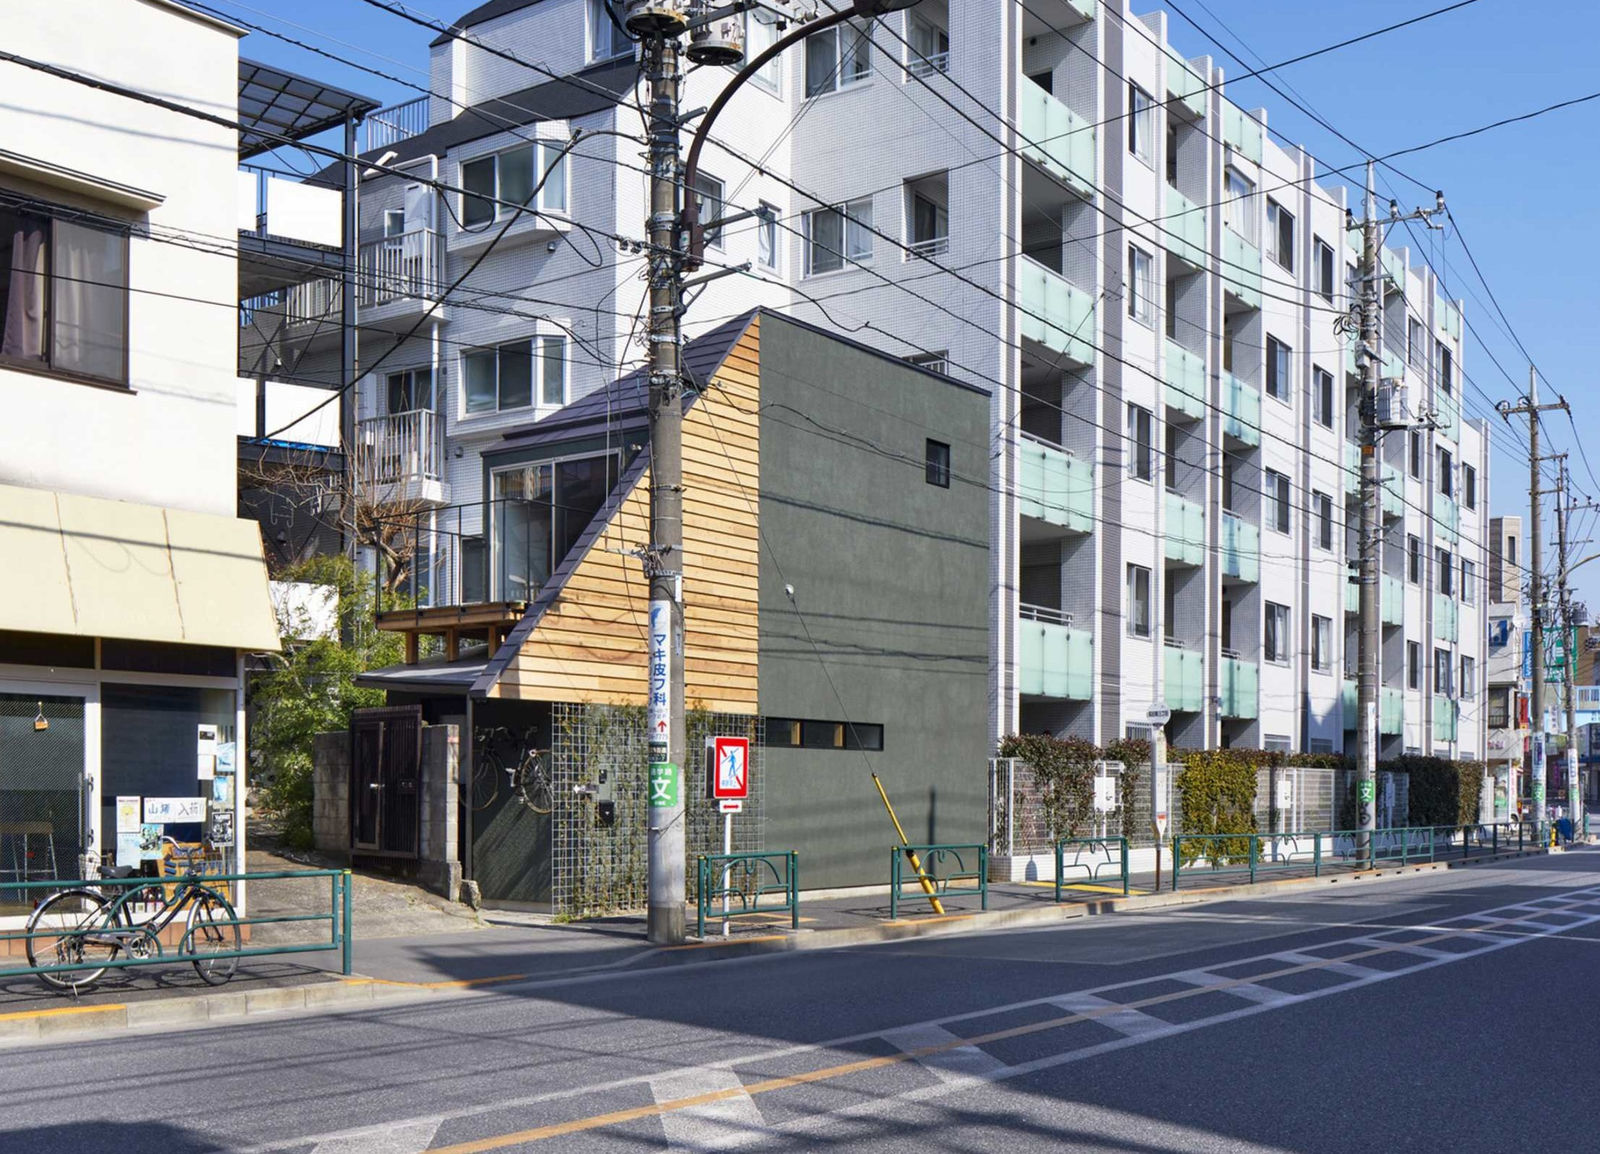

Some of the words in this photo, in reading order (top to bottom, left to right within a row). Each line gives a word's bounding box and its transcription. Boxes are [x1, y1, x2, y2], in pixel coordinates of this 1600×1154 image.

[652, 633, 667, 706] マキ皮フ科
[651, 776, 672, 800] 文
